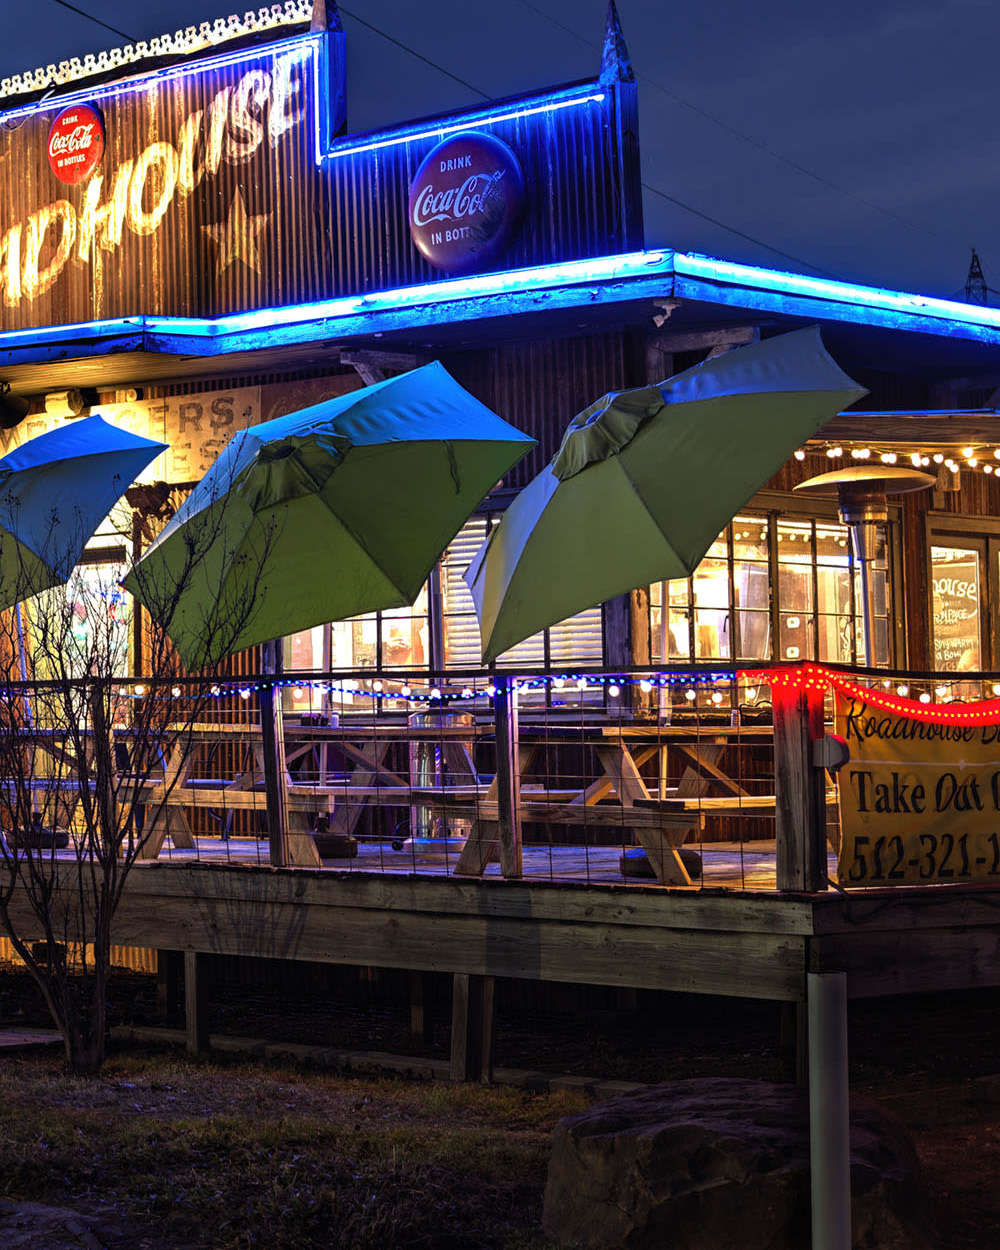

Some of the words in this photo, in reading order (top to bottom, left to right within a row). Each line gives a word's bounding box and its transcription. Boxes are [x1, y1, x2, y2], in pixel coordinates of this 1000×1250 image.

[62, 115, 79, 126] DRINK
[49, 123, 95, 157] Coca-Cola
[57, 160, 64, 168] IN
[64, 153, 86, 166] BOTTLES
[440, 155, 472, 172] DRINK
[431, 233, 442, 245] IN
[849, 770, 926, 813] Take
[848, 832, 1000, 881] 512-321-1
